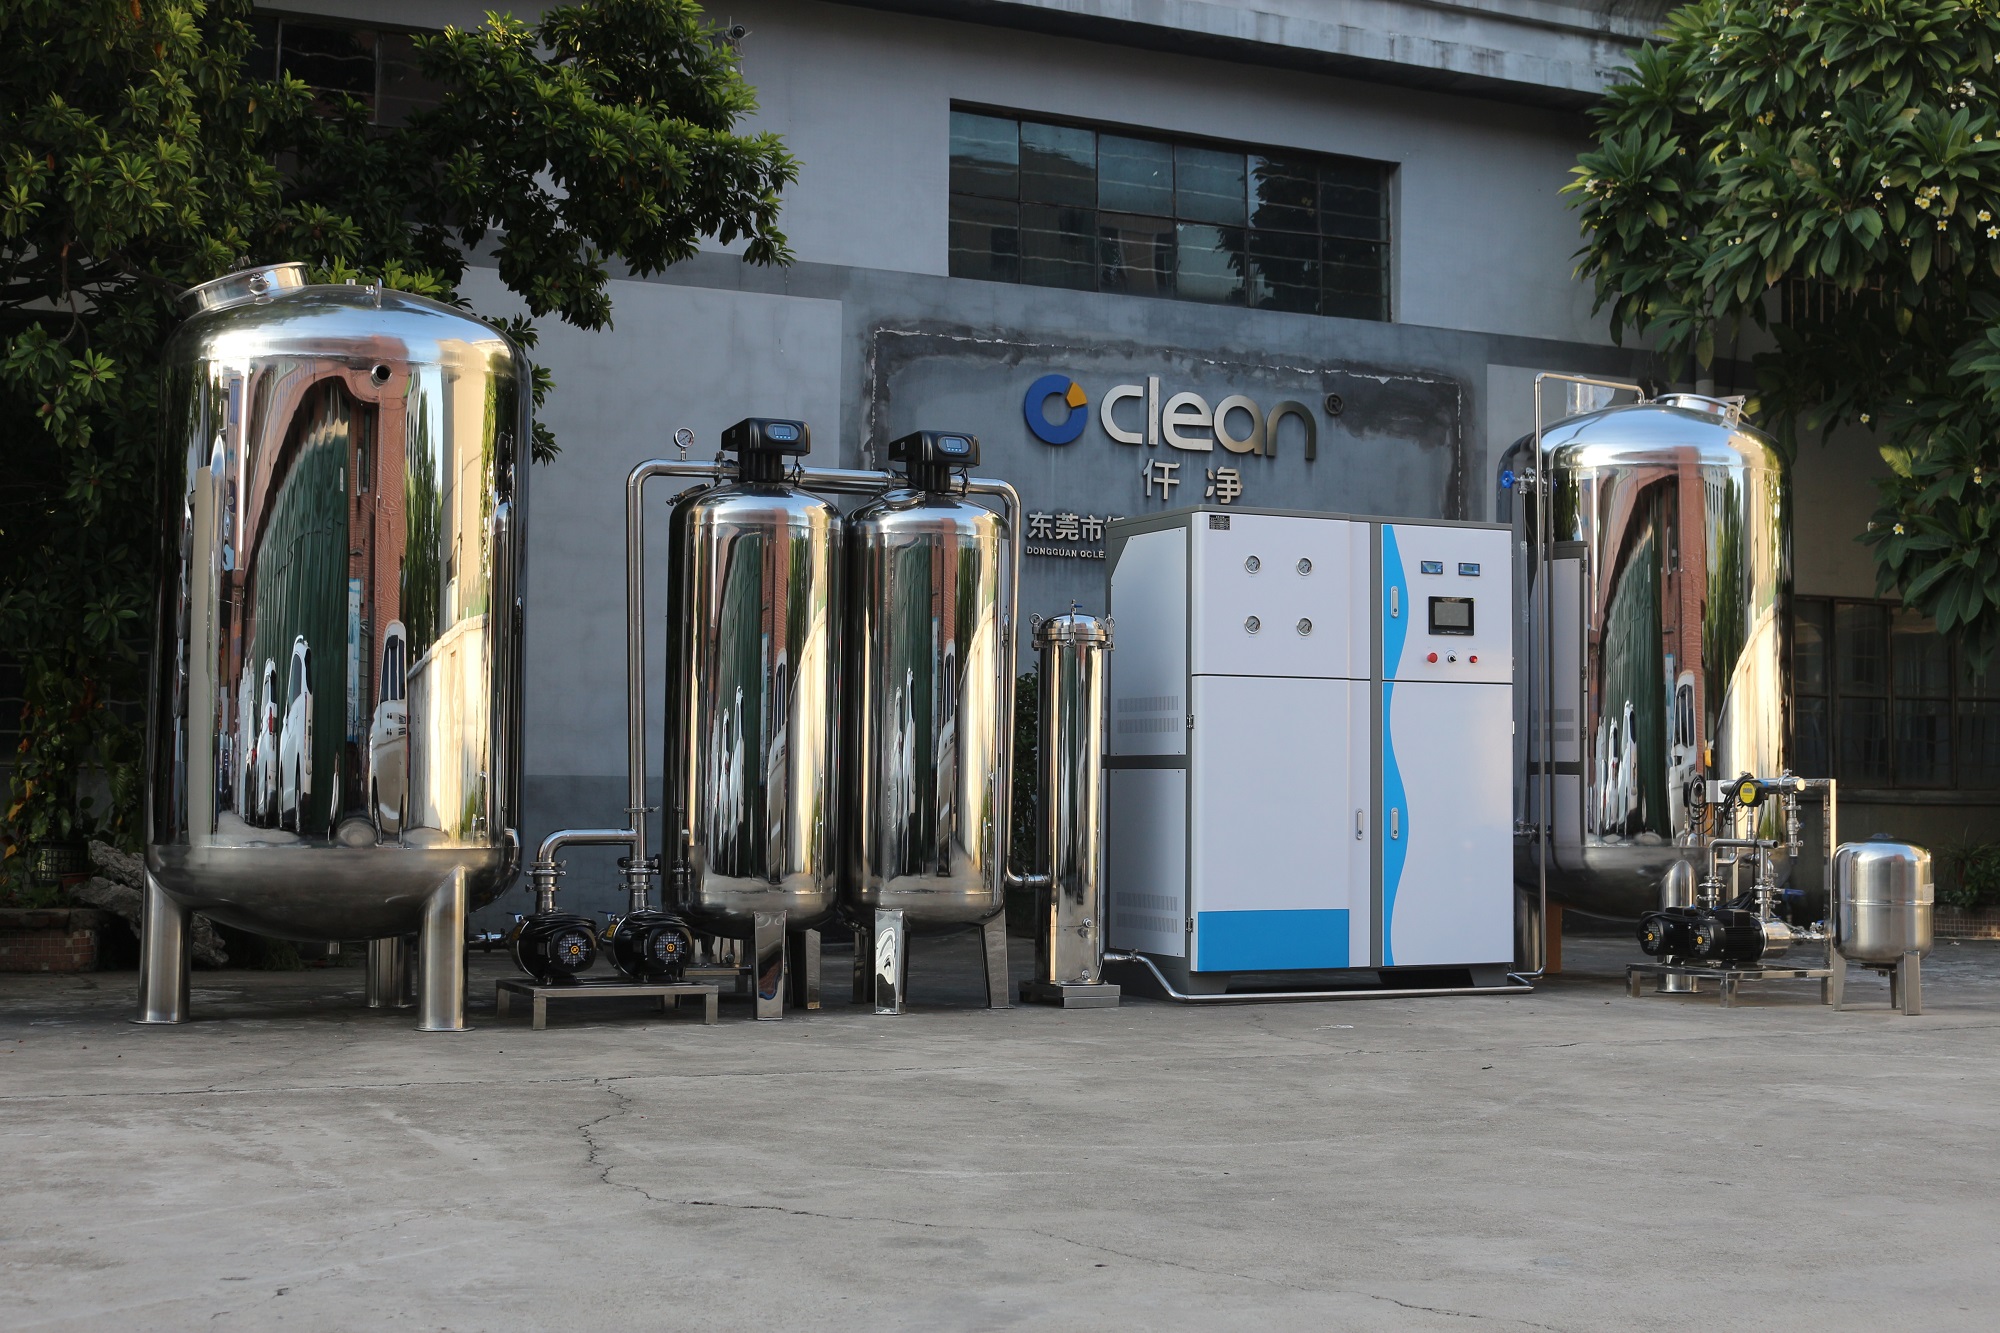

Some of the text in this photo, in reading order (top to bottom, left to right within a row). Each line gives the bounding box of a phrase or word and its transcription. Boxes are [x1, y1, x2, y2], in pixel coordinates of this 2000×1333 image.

[1027, 511, 1125, 541] 东莞市
[1026, 545, 1107, 559] DONGGUAN QCLE
